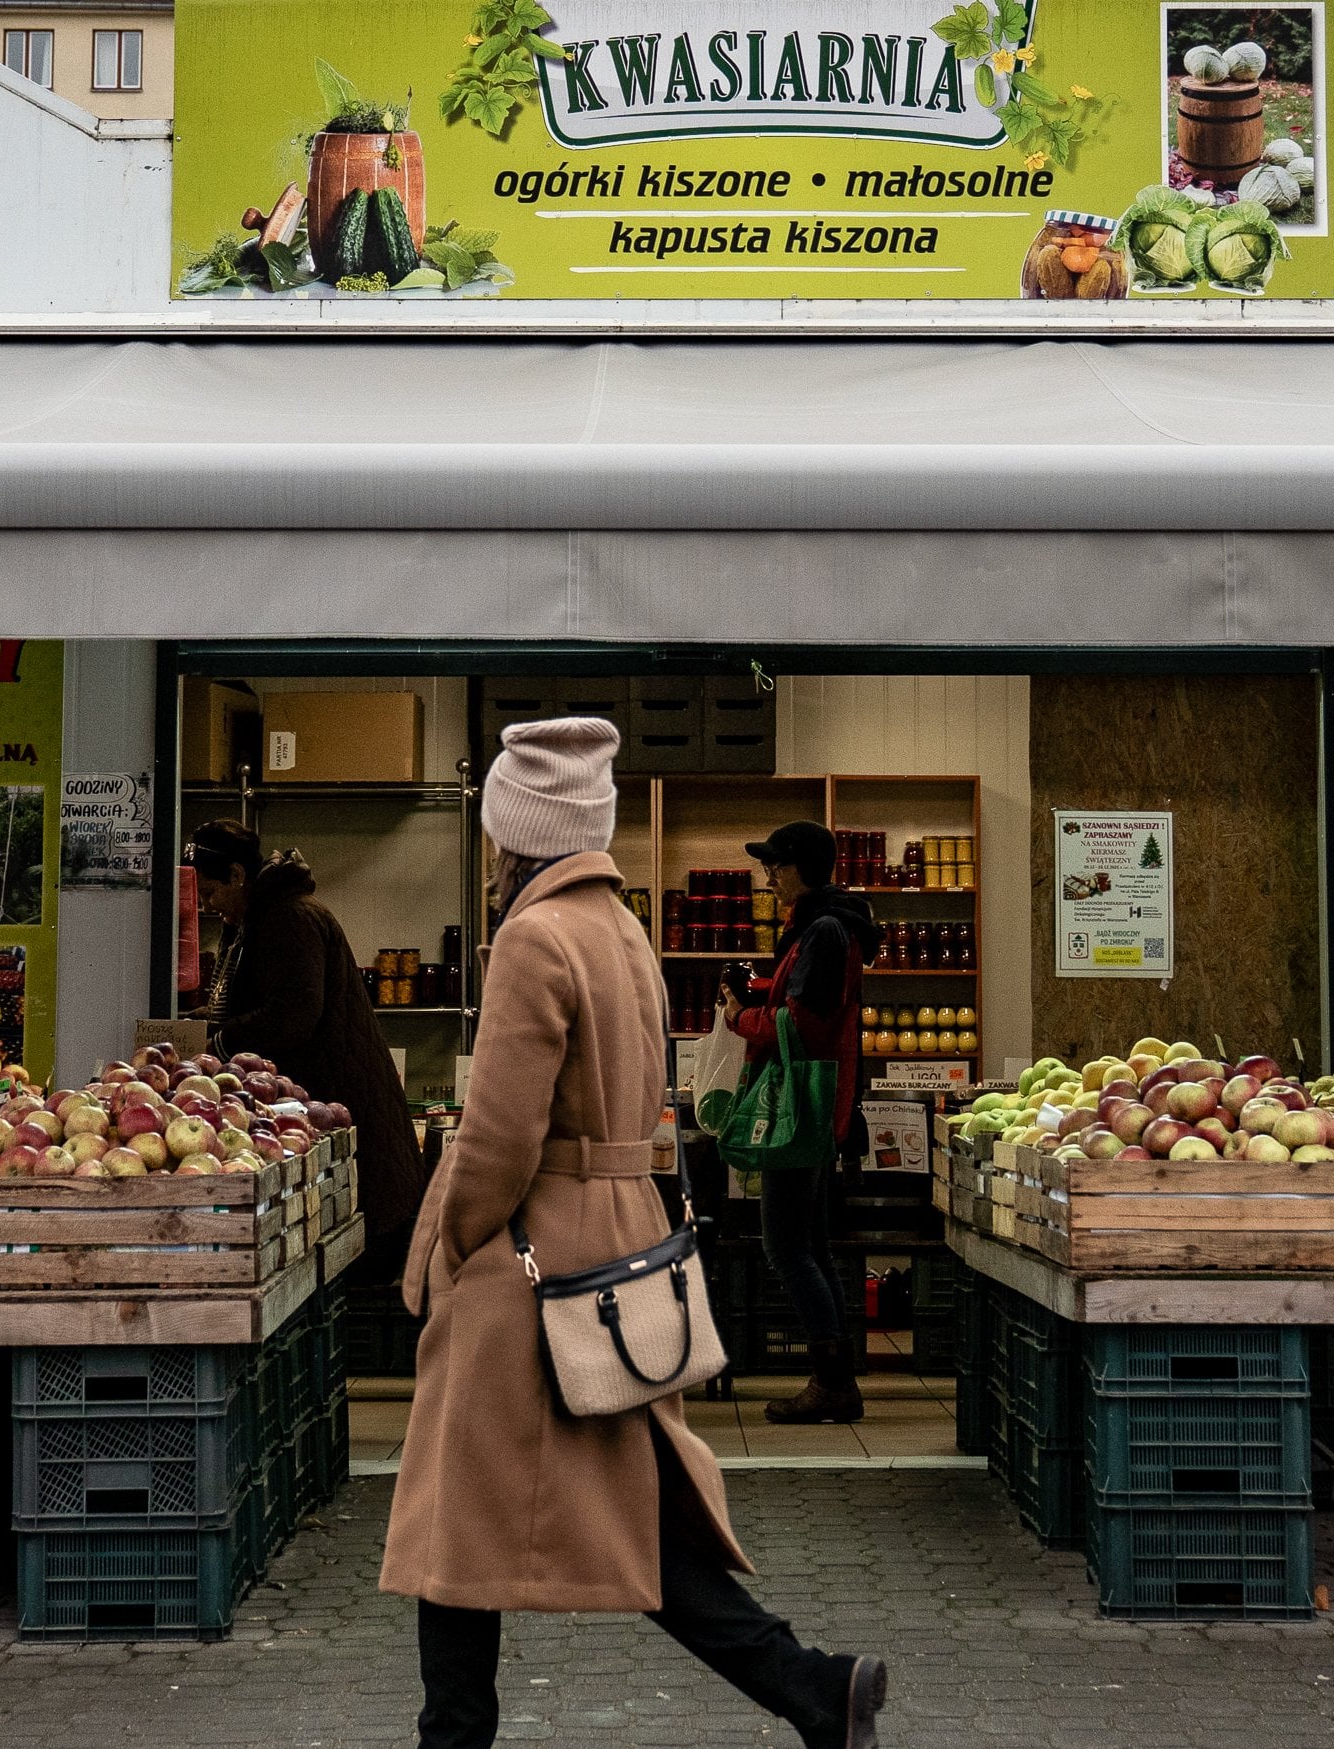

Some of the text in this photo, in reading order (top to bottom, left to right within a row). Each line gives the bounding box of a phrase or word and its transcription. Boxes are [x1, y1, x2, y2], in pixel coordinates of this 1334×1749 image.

[563, 30, 967, 115] KWASIARNIA
[494, 161, 1055, 204] ogórki kiszone małosolne
[608, 221, 938, 258] kapusta kiszona
[1082, 822, 1122, 830] SZANOWNI
[876, 1081, 952, 1090] ZAKWAS BURACZANY
[987, 1081, 1020, 1089] ZAKWAS
